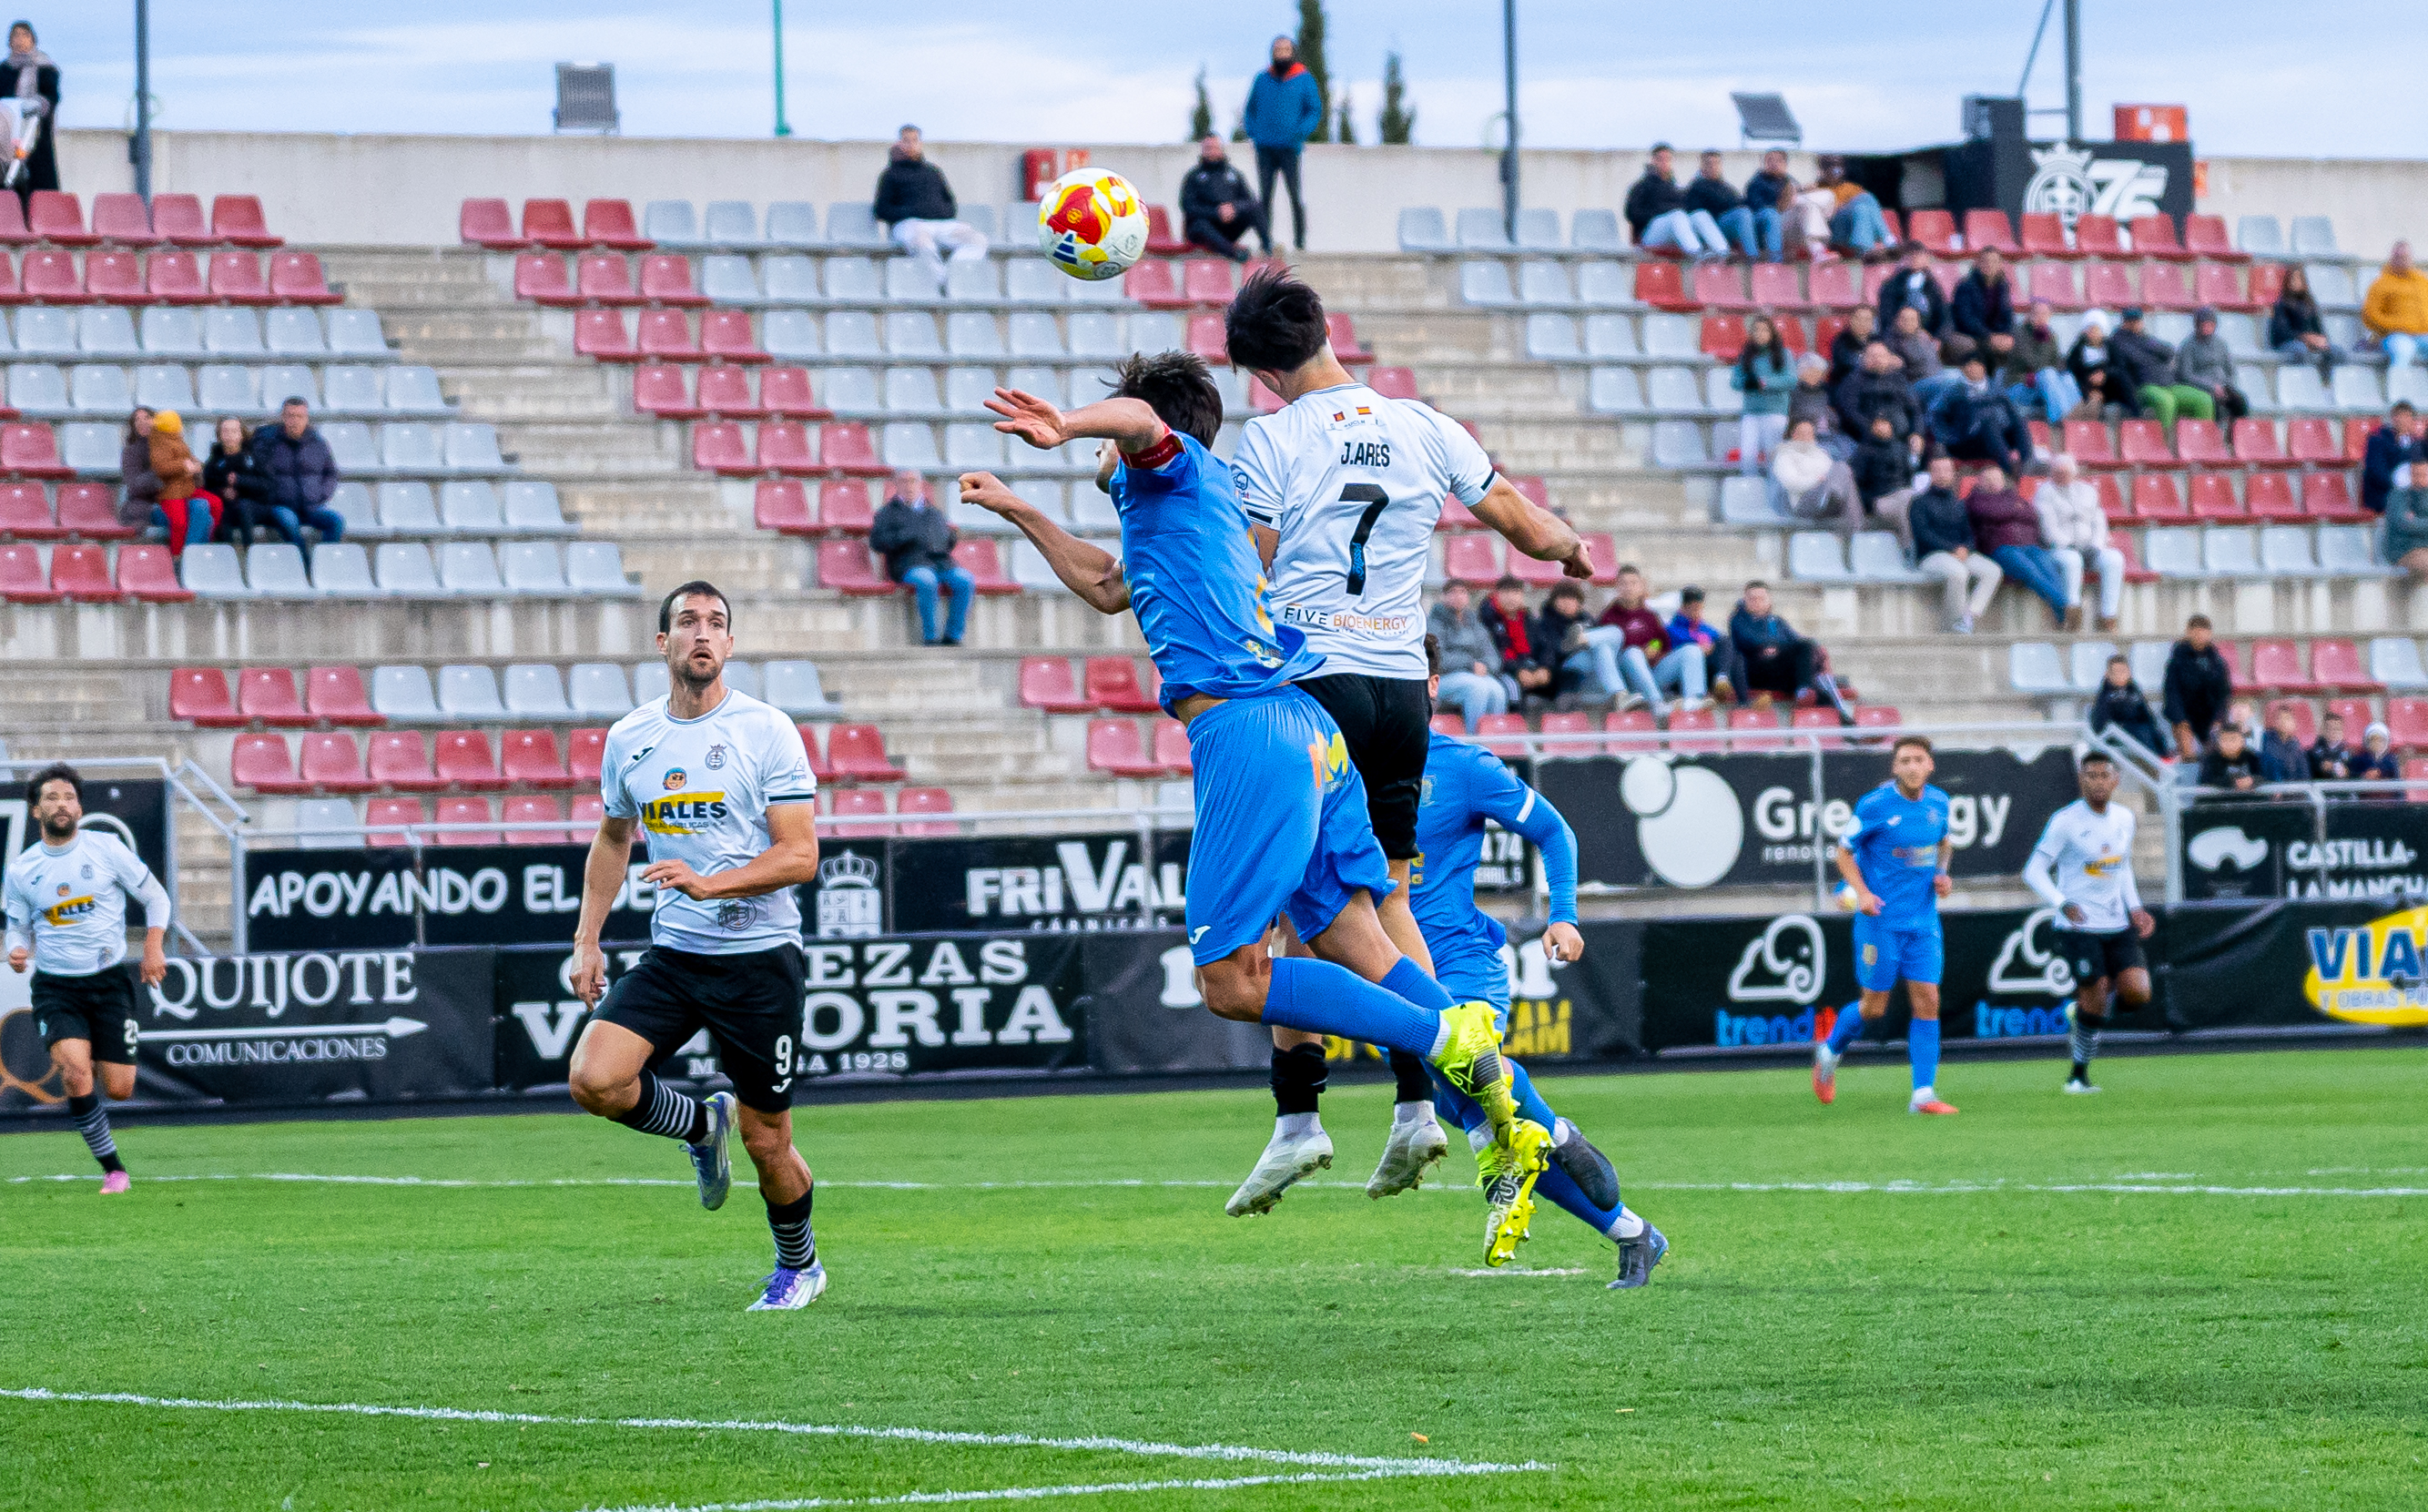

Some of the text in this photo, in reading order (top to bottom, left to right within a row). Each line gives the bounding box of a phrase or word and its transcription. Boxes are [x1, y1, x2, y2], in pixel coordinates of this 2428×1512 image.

[1340, 441, 1390, 467] J.ARES
[1337, 482, 1389, 596] 7
[1284, 606, 1328, 625] FIVE
[1333, 614, 1408, 631] BIOENERGY
[1753, 786, 2012, 847] Gregy
[2287, 838, 2418, 868] CASTILLA-
[248, 867, 509, 918] APOYANDO
[523, 863, 580, 913] EL
[2306, 927, 2428, 981] VIA
[148, 952, 418, 1020] QUIJOTE
[167, 1038, 387, 1067] COMUNICACIONES
[776, 1034, 792, 1076] 9
[838, 1050, 909, 1071] 1928
